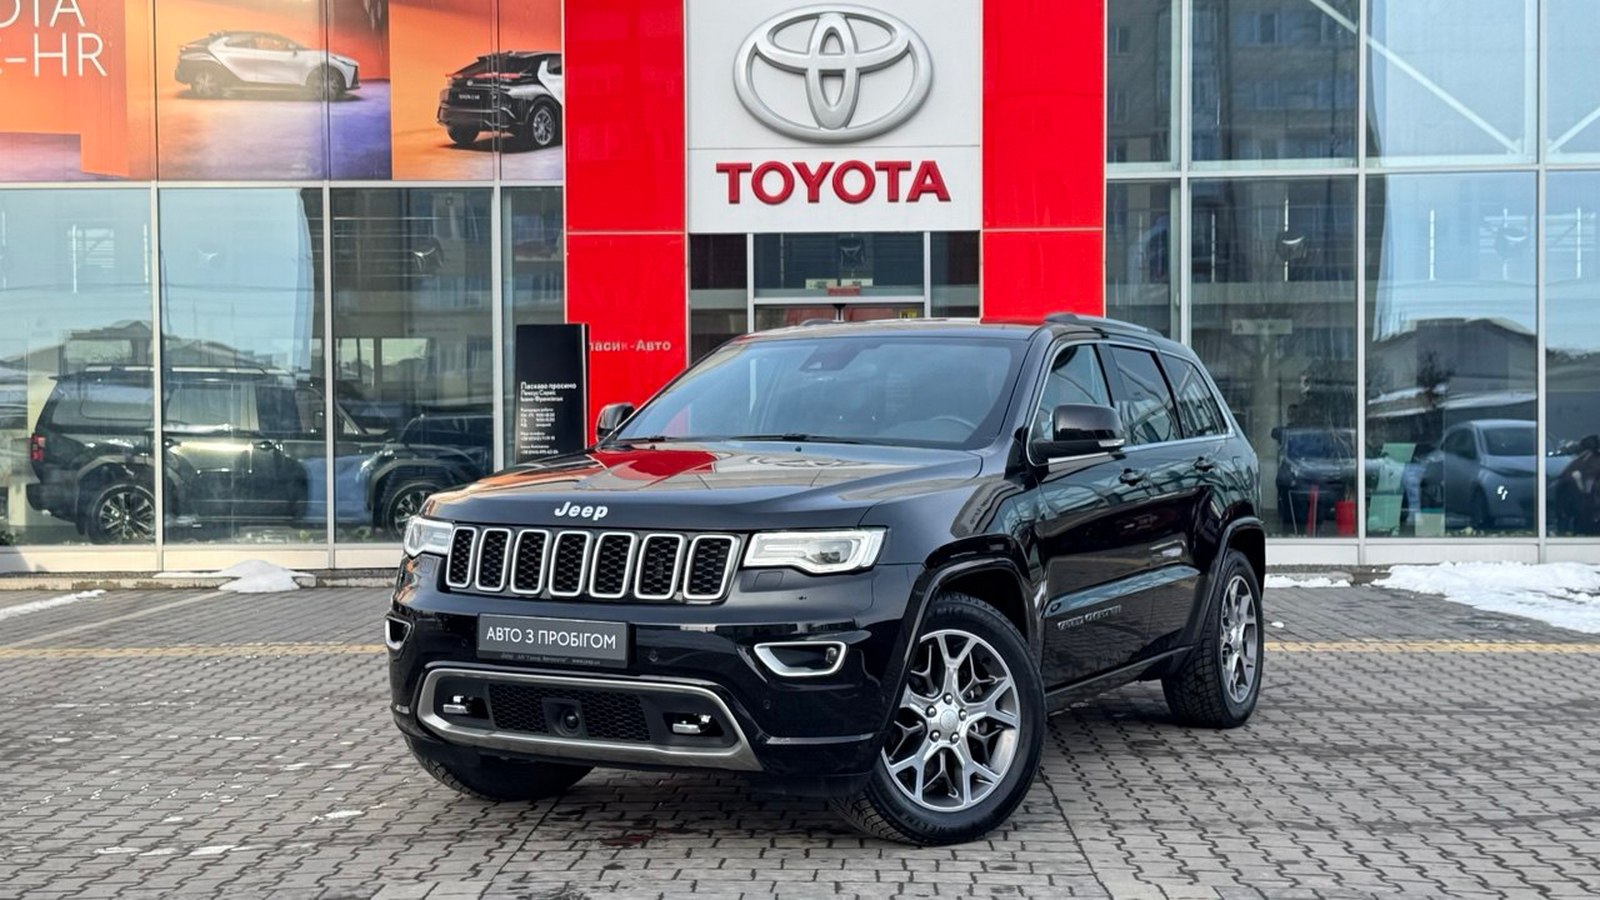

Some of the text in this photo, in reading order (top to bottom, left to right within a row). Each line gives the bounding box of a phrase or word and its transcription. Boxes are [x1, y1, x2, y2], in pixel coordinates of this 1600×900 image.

[0, 32, 108, 77] -HR
[716, 160, 952, 205] TOYOTA
[554, 501, 608, 521] Jeep
[486, 626, 616, 649] АВТО З ПРОБІГОМ
